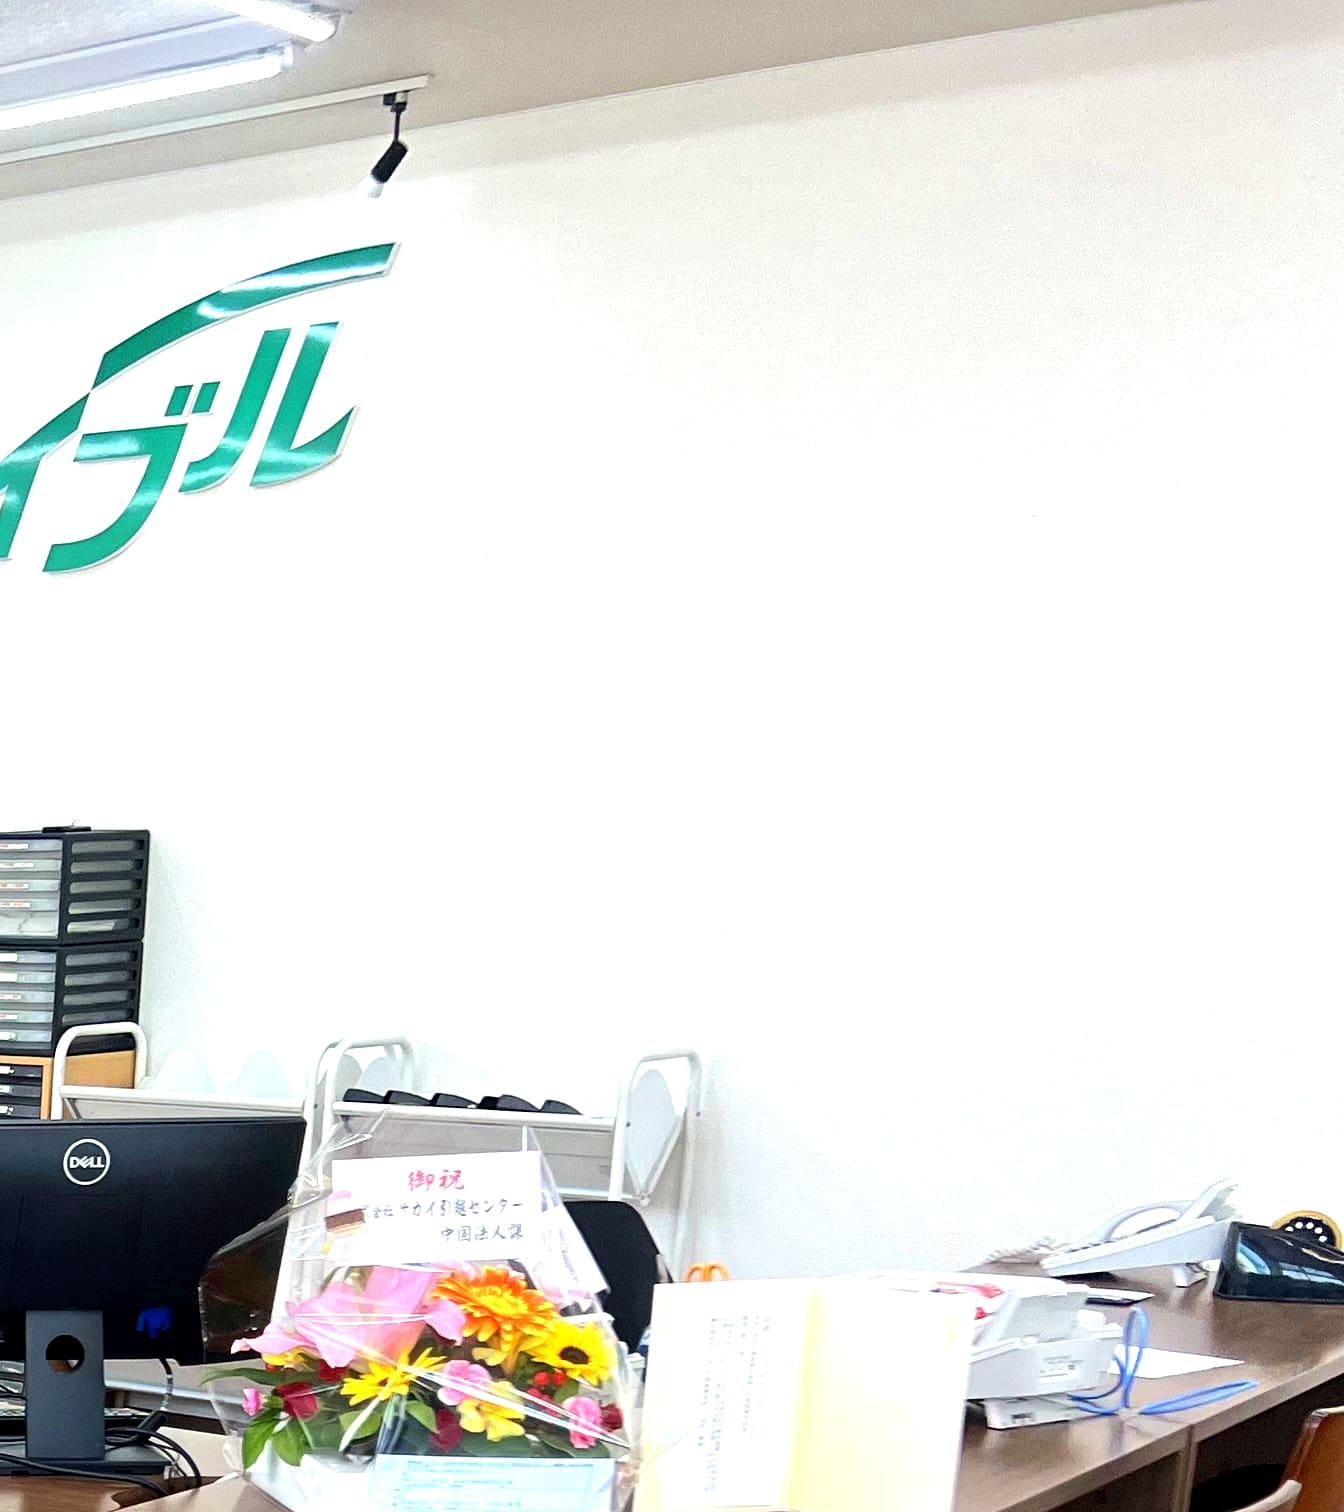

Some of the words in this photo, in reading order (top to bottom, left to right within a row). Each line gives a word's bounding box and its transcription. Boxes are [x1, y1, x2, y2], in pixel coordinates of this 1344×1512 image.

[69, 1155, 105, 1169] DELL
[407, 1168, 466, 1192] 御祝
[440, 1222, 525, 1243] 中国法人課
